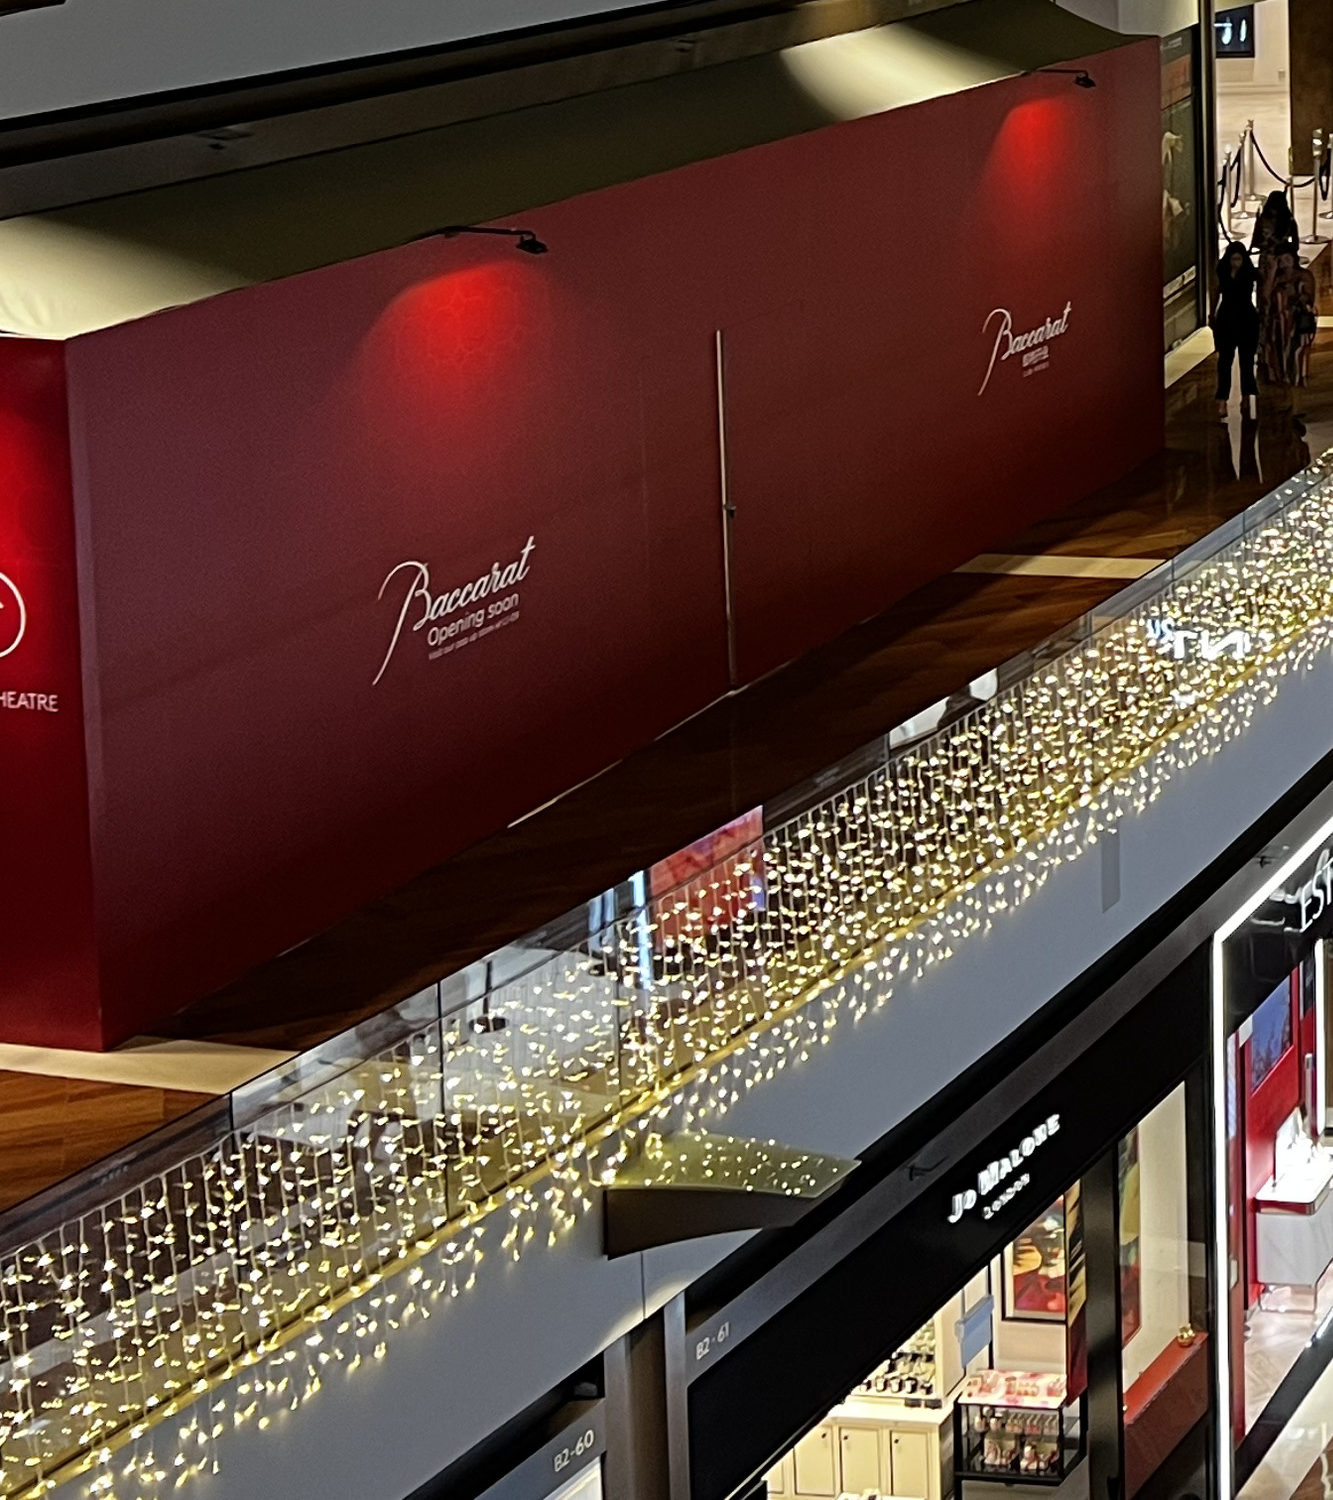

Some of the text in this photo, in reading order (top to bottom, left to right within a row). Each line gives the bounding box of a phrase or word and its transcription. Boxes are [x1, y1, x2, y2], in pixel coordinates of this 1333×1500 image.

[978, 301, 1072, 396] Baccarat
[372, 535, 536, 686] Baccarat
[427, 609, 485, 646] Opening
[487, 593, 519, 619] soon
[553, 1429, 595, 1473] B2-60
